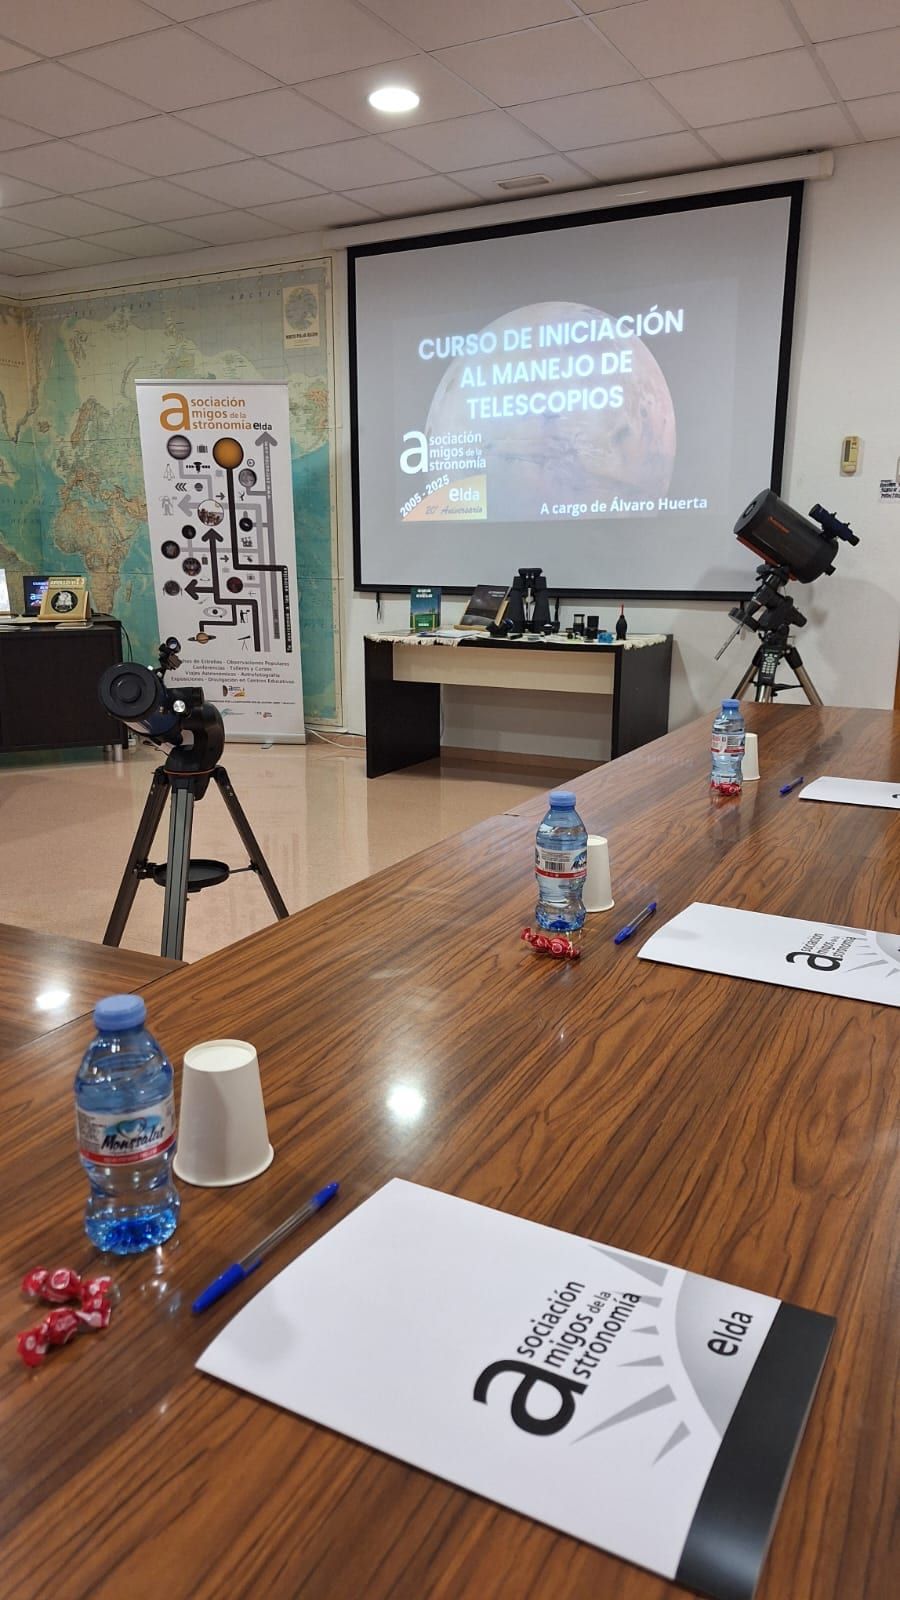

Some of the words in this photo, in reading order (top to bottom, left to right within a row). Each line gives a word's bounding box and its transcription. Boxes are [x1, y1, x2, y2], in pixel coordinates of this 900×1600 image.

[418, 331, 497, 360] CURSO
[503, 327, 532, 352] DE
[538, 305, 685, 348] INICIACIÓN
[460, 366, 486, 389] AL
[492, 354, 595, 386] MANEJO
[601, 350, 633, 375] DE
[192, 408, 228, 421] migos
[466, 385, 624, 420] TELESCOPIOS
[253, 422, 272, 431] elda
[429, 446, 464, 460] migos
[465, 449, 474, 457] de
[476, 448, 482, 456] la
[400, 492, 422, 518] 2005
[425, 474, 450, 495] 2025
[449, 487, 480, 502] elda
[540, 503, 550, 515] A
[552, 503, 587, 517] cargo
[590, 500, 607, 513] de
[610, 496, 655, 512] Álvaro
[658, 498, 708, 510] Huerta
[587, 1301, 606, 1314] de
[593, 1291, 612, 1301] la
[516, 1280, 586, 1358] sociación
[572, 1291, 642, 1379] stronomía
[707, 1311, 754, 1357] elda
[543, 1312, 593, 1368] migos
